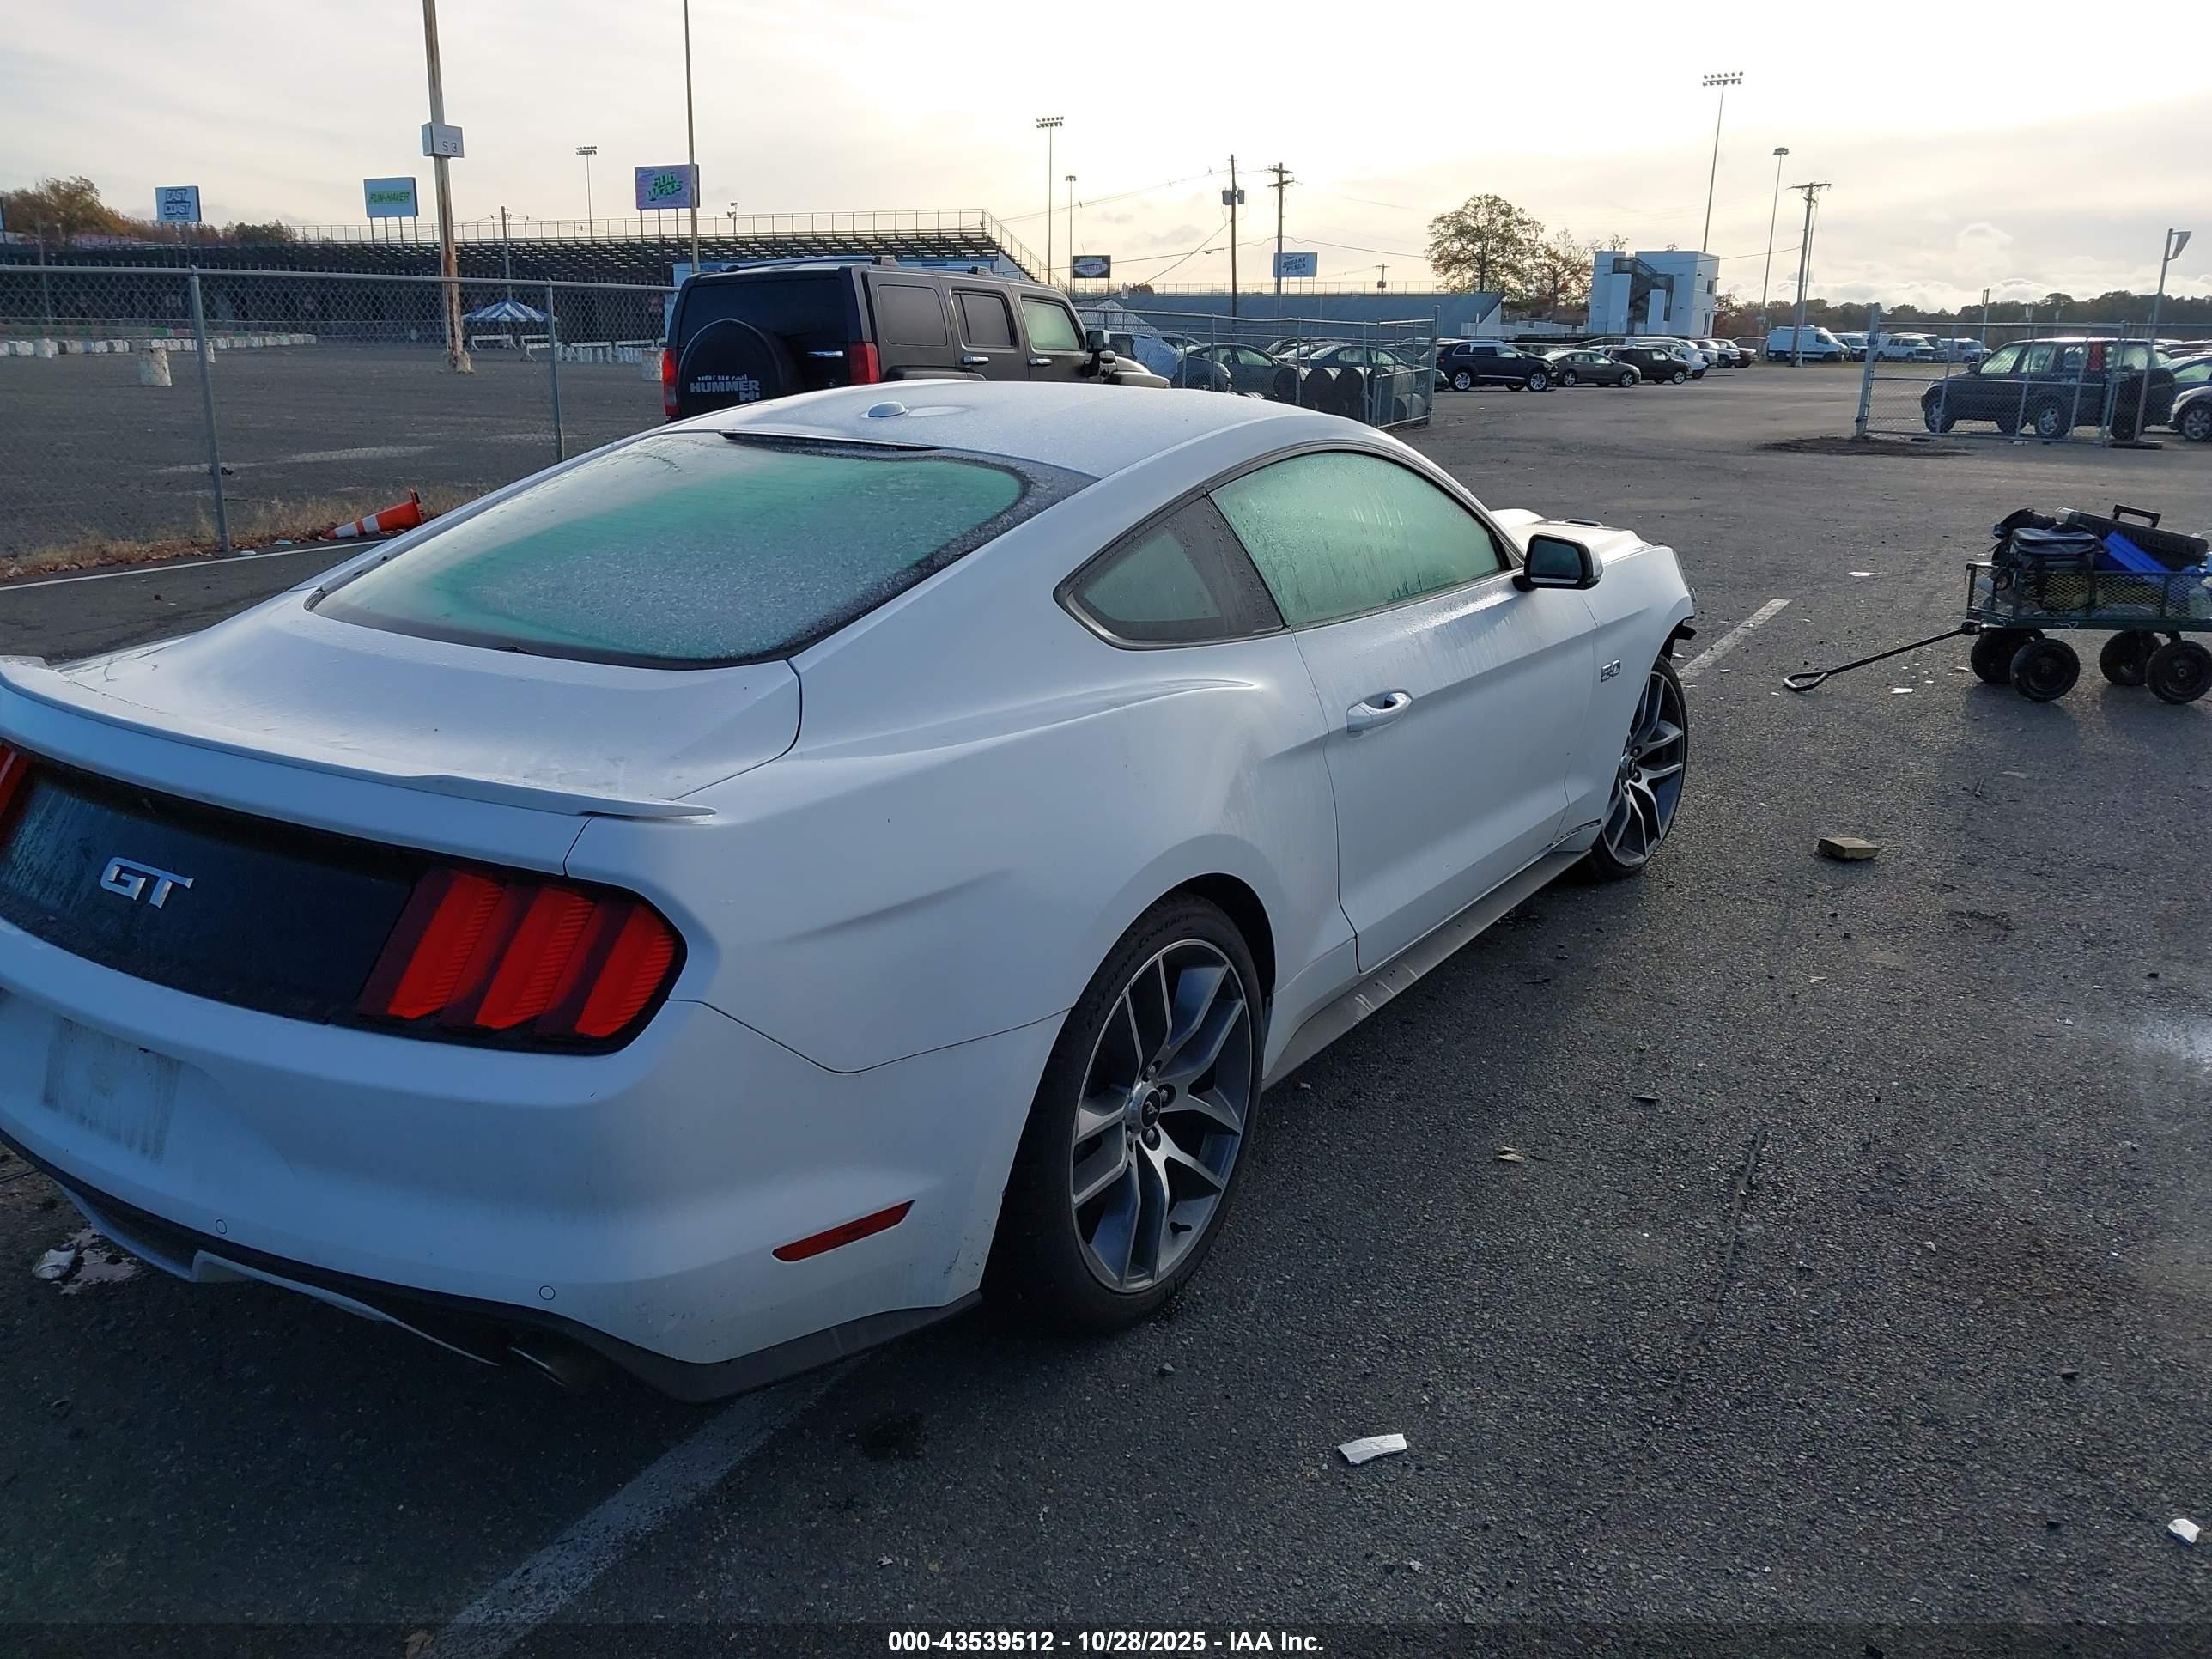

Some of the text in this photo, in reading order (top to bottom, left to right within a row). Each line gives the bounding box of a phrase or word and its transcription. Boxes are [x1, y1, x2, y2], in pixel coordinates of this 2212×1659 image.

[165, 188, 187, 201] EAST
[164, 201, 191, 215] COAST
[690, 380, 760, 393] HUMMER
[100, 857, 194, 909] GT
